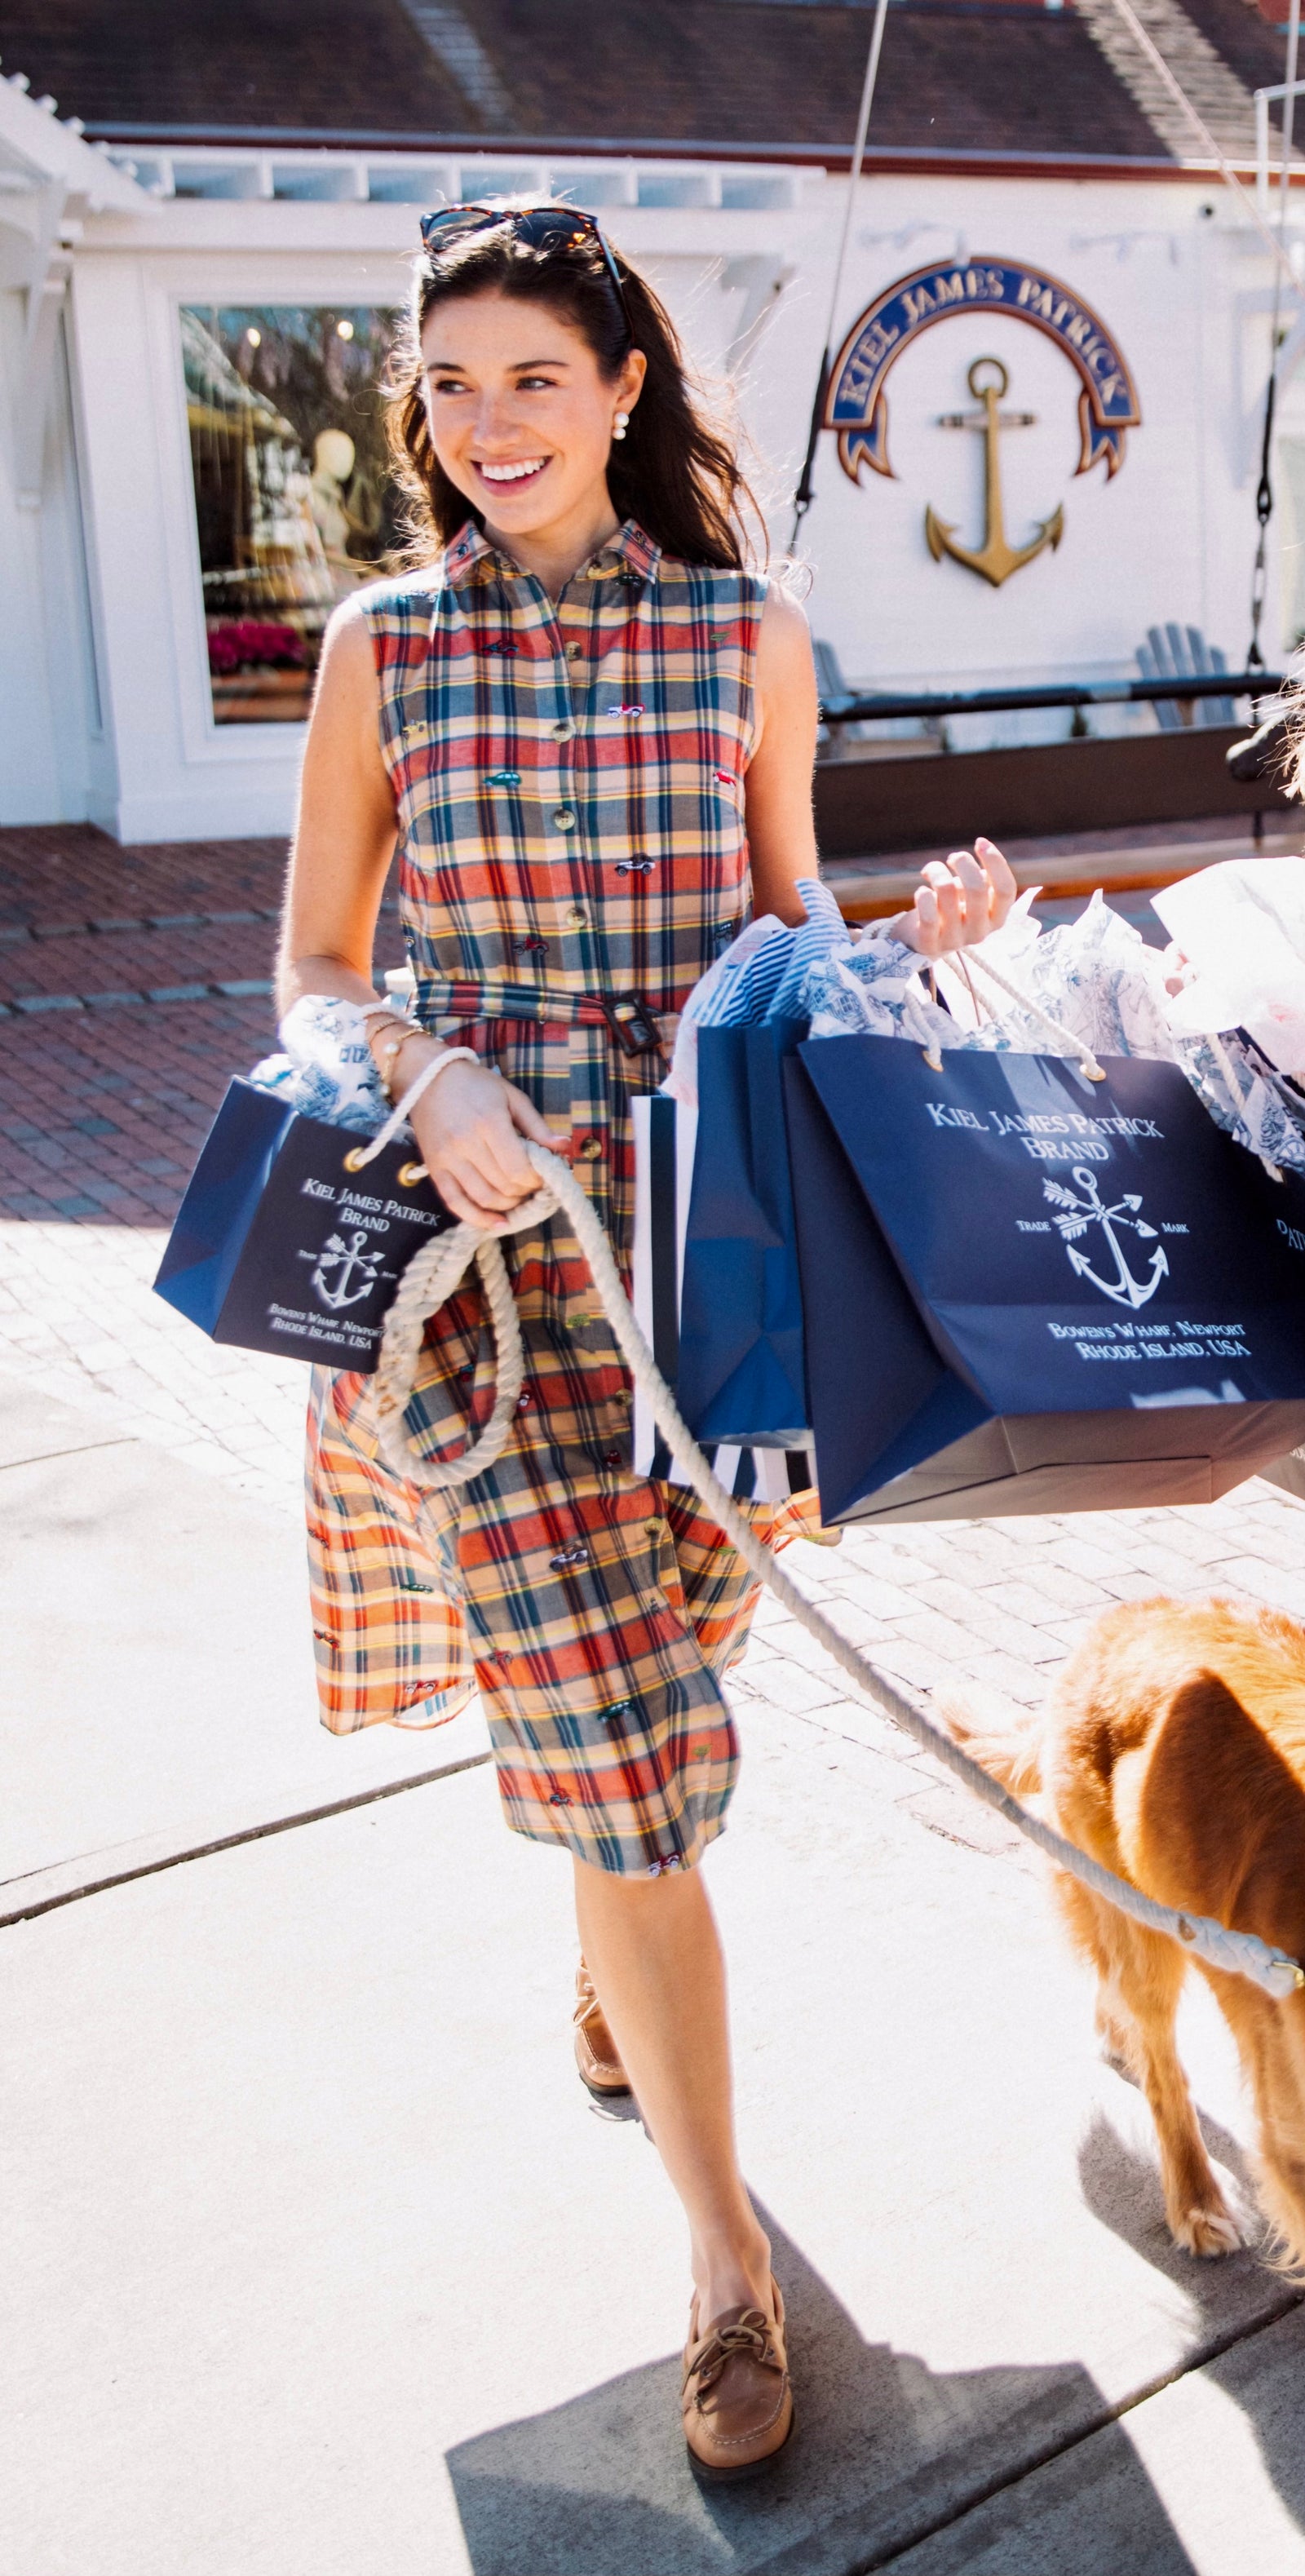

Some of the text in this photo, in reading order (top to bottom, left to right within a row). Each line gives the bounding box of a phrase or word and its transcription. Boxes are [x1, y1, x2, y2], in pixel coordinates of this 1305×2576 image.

[840, 268, 1128, 405] KIEL JAMES PATRICK
[925, 1103, 1165, 1137] KIEL JAMES PATRICK
[1020, 1136, 1109, 1161] BRAND
[302, 1178, 441, 1226] KIEL JAMES PATRICK
[339, 1207, 390, 1233] BRAND
[1015, 1220, 1051, 1233] TRADE
[1161, 1222, 1190, 1233] MARK
[1276, 1219, 1305, 1250] PAT
[272, 1317, 308, 1334] RHODE
[349, 1335, 372, 1350] USA
[1175, 1321, 1246, 1338] NEWPORT
[1074, 1342, 1142, 1360] RHODE
[1206, 1339, 1253, 1357] USA
